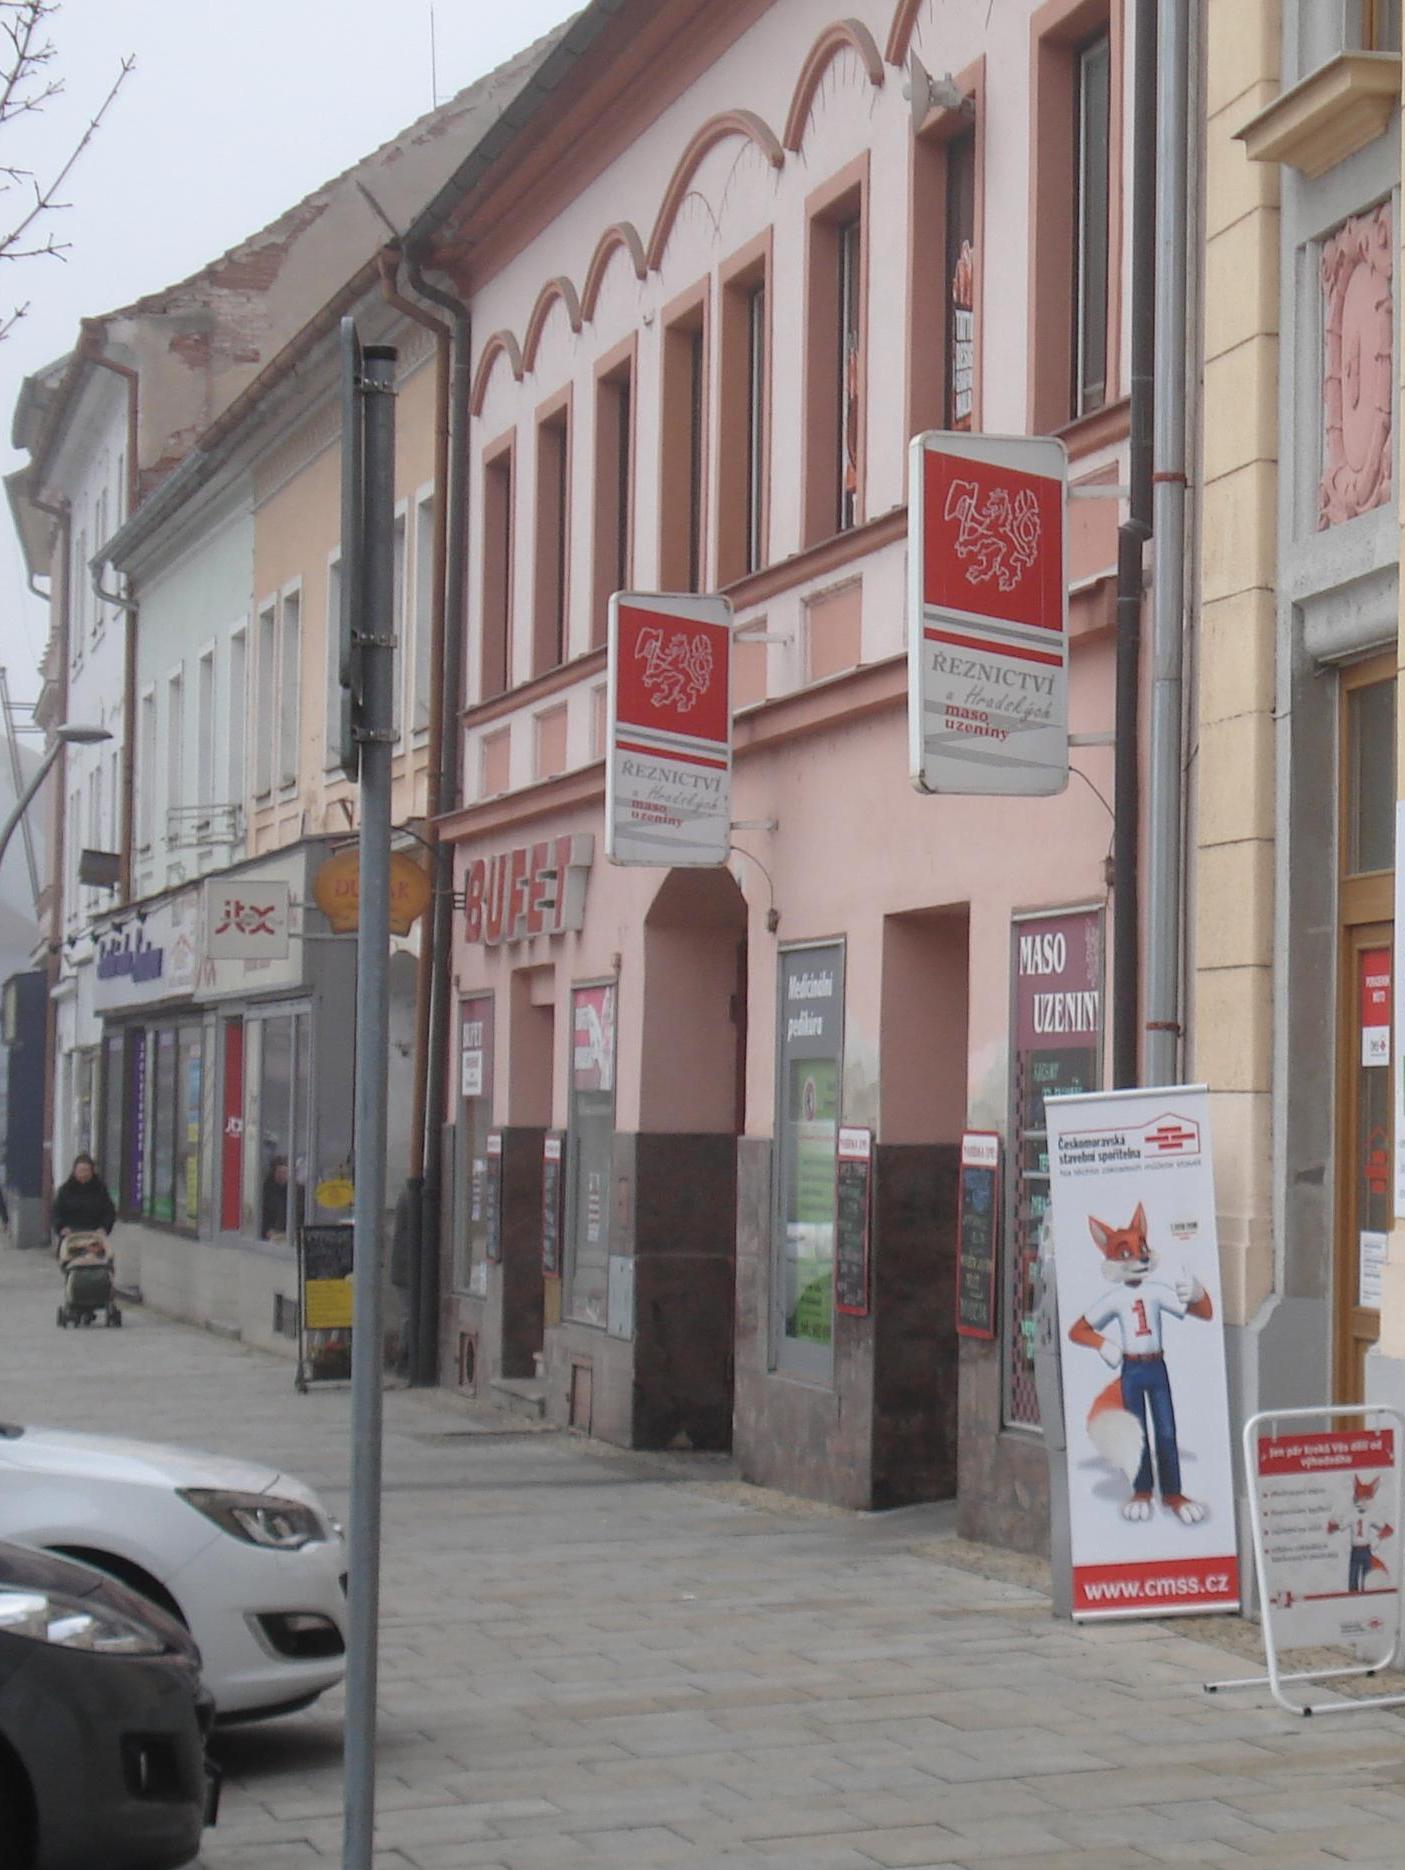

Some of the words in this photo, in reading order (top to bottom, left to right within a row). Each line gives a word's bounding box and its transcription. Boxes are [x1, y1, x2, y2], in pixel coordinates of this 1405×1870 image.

[932, 652, 1055, 696] ŘEZNICTVÍ
[945, 719, 1008, 742] uzeniny
[622, 760, 722, 792] ŘEZNICTVÍ
[632, 810, 683, 829] uzeniny
[465, 834, 573, 944] BUFET
[1019, 932, 1066, 975] MASO
[1058, 1134, 1125, 1150] Českomoravská
[1059, 1150, 1096, 1165] stavební
[1098, 1148, 1141, 1163] spořitelna
[1132, 1299, 1152, 1337] 1
[1084, 1573, 1229, 1600] www.cmss.cz
